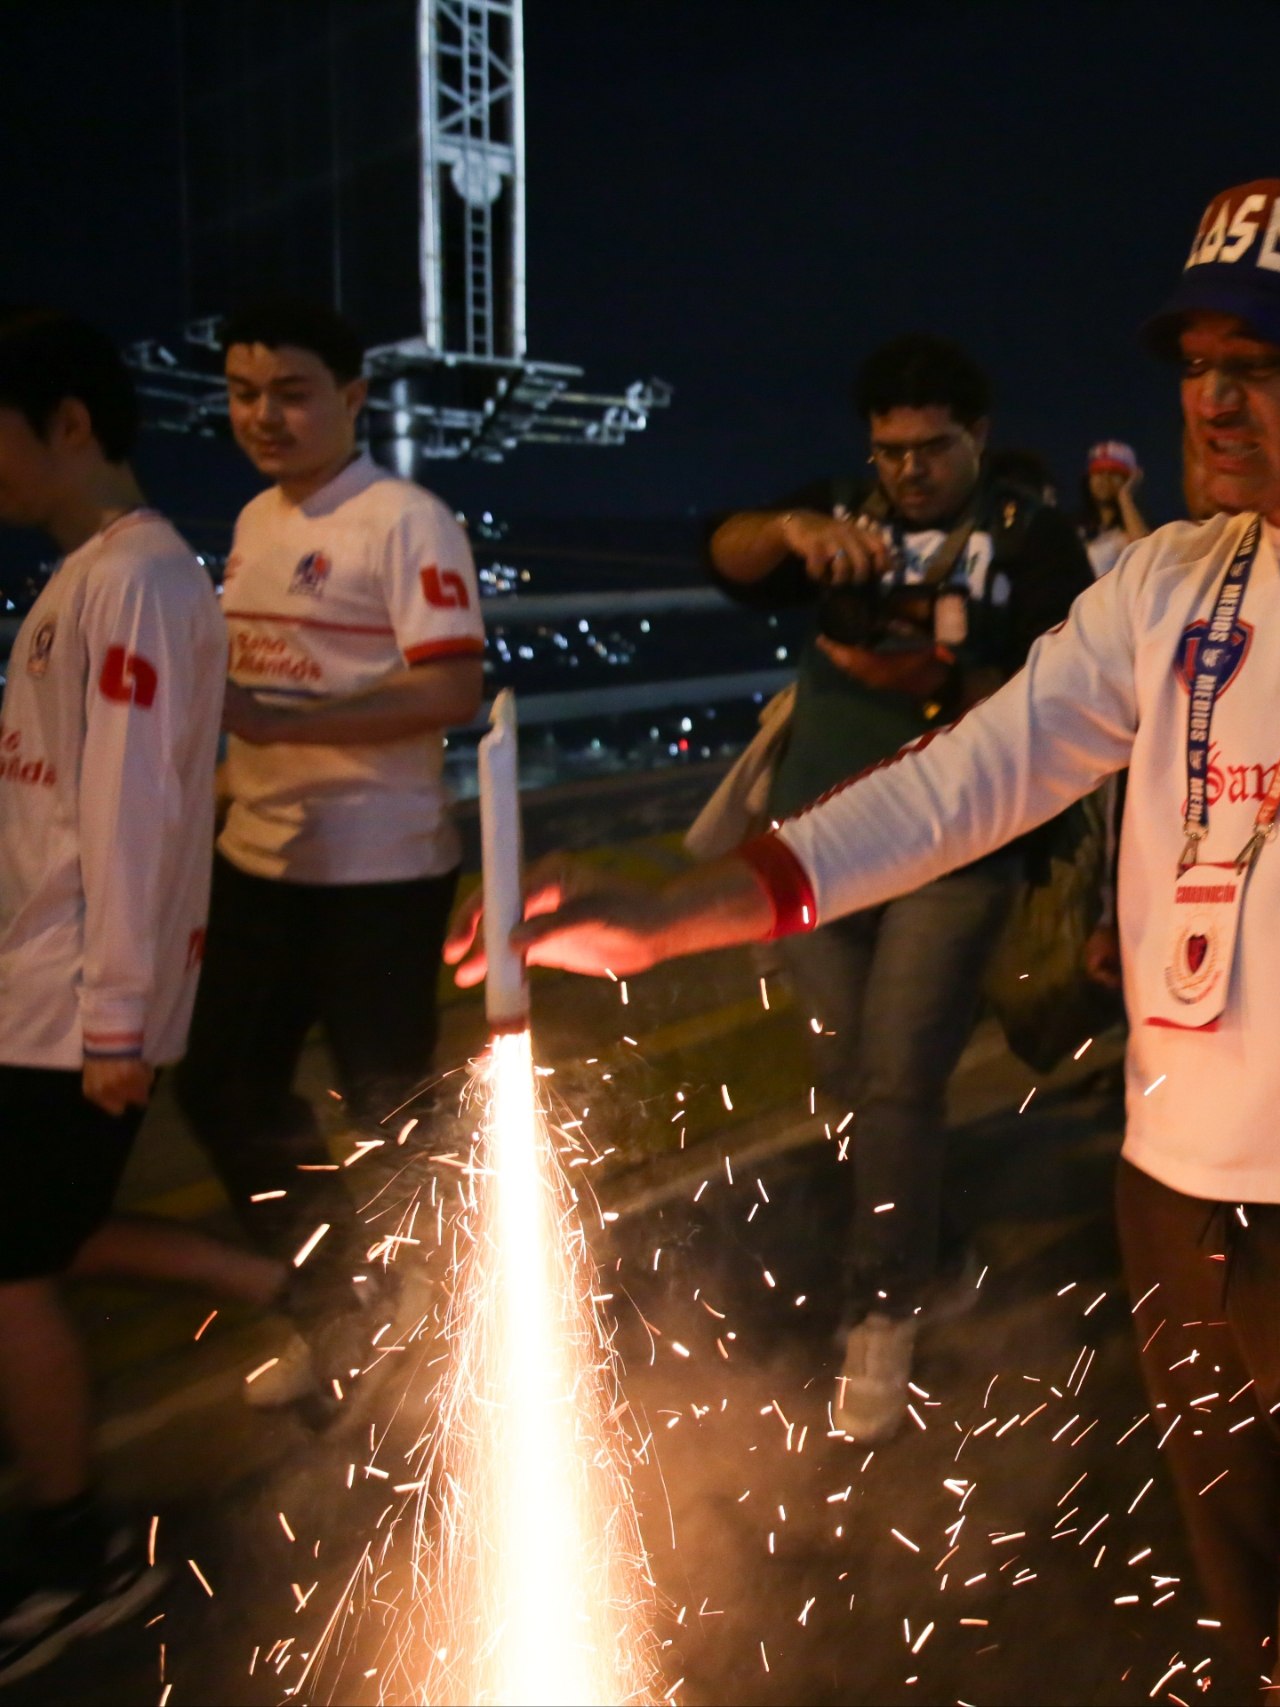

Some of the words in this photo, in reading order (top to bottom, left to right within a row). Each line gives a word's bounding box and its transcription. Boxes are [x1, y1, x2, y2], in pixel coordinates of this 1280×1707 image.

[1208, 584, 1242, 642] MEDIOS
[1189, 674, 1217, 742] MEDIOS
[1187, 776, 1204, 823] MEDI
